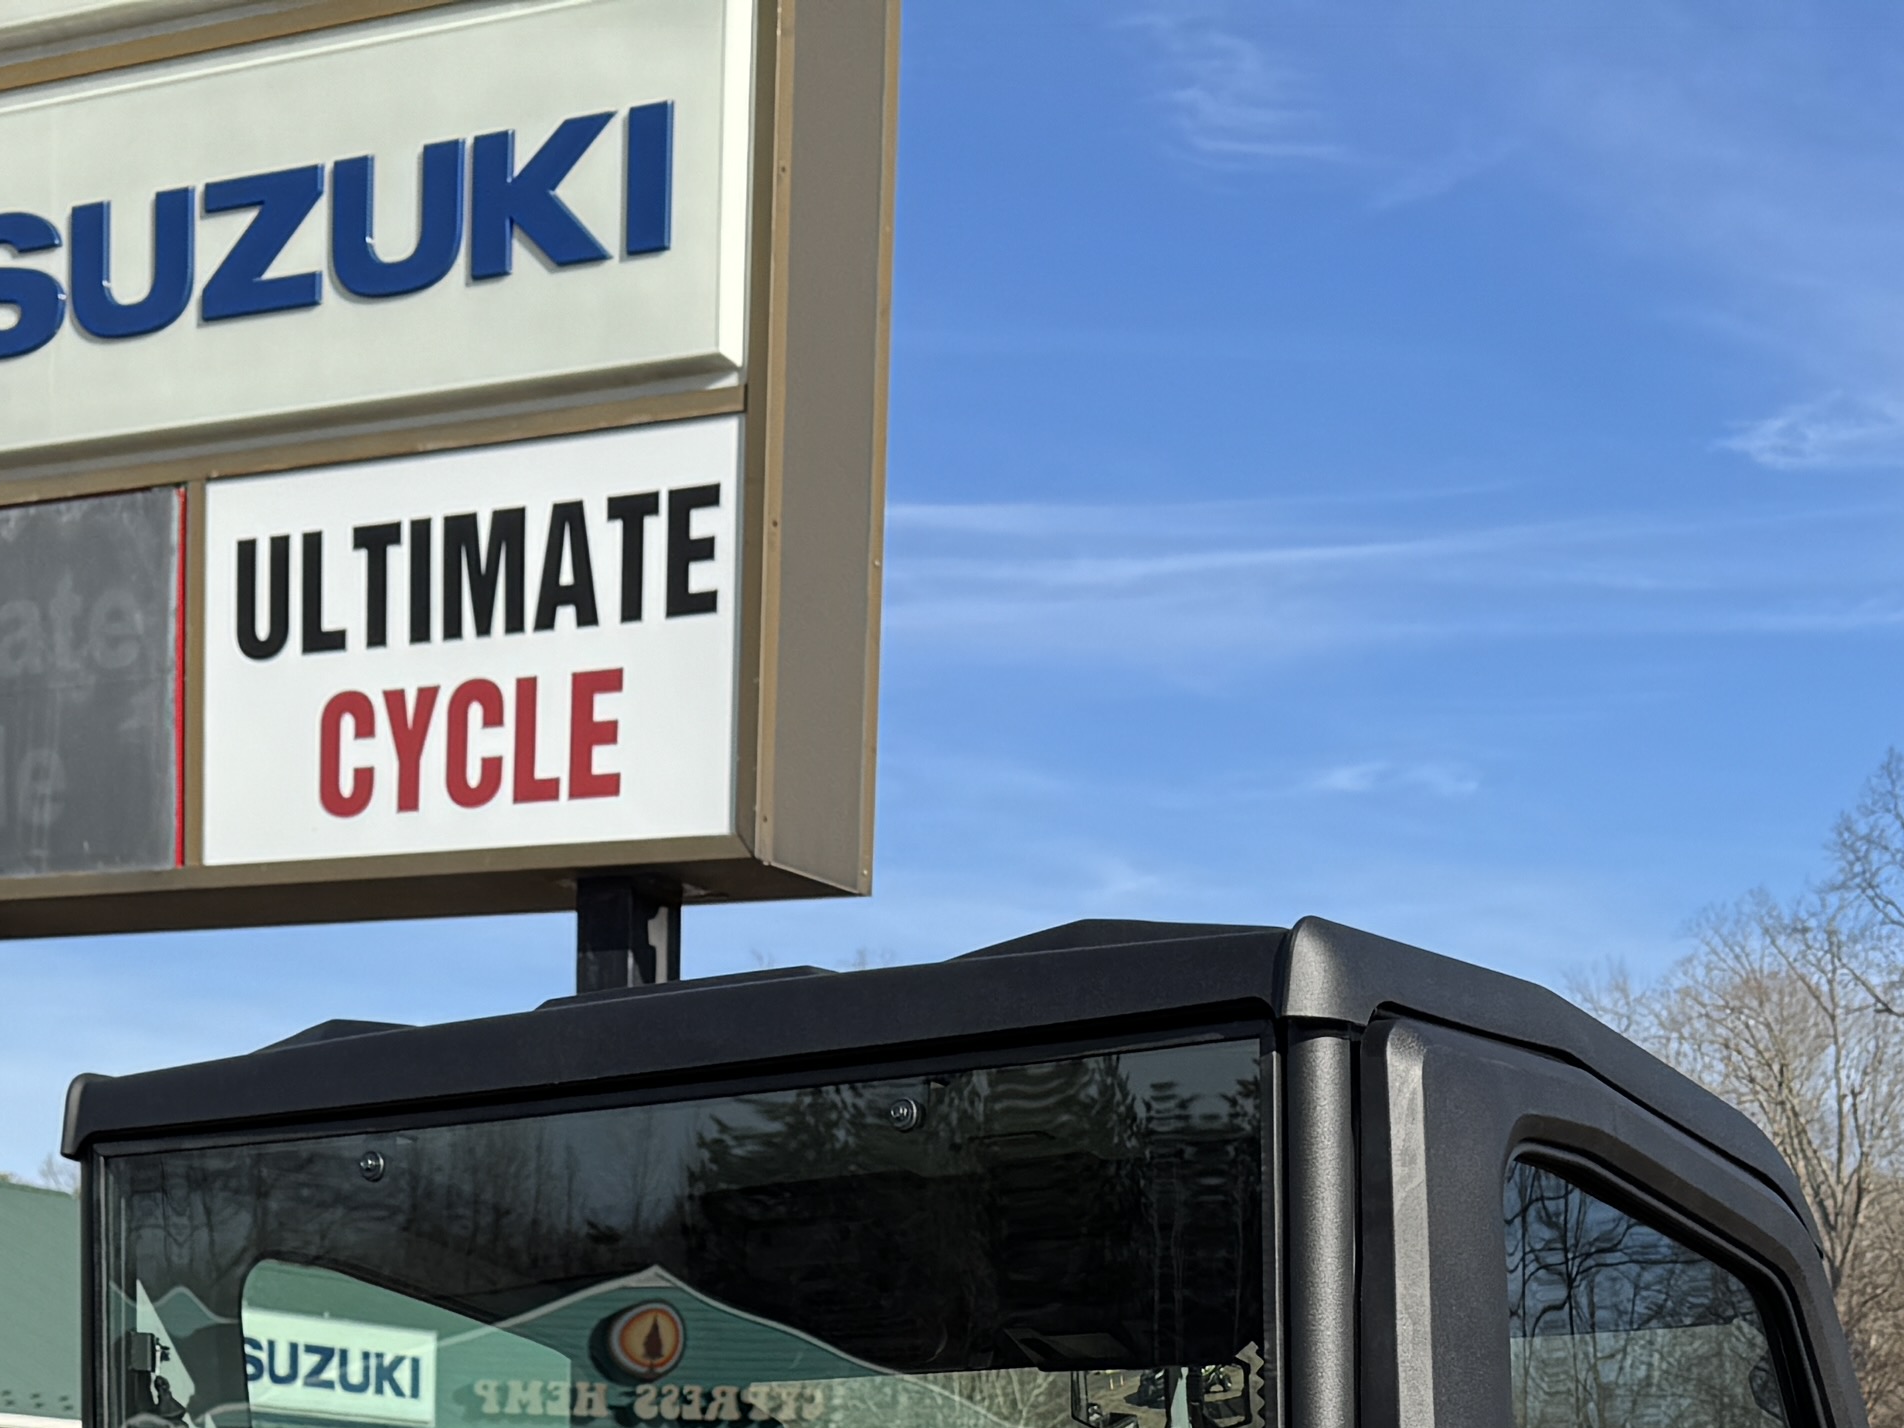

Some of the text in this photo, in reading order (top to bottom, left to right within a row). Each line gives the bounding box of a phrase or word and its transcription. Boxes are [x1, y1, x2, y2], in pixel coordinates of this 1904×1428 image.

[235, 482, 721, 661] ULTIMATE
[318, 666, 625, 819] CYCLE
[243, 1336, 421, 1400] SUZUKI
